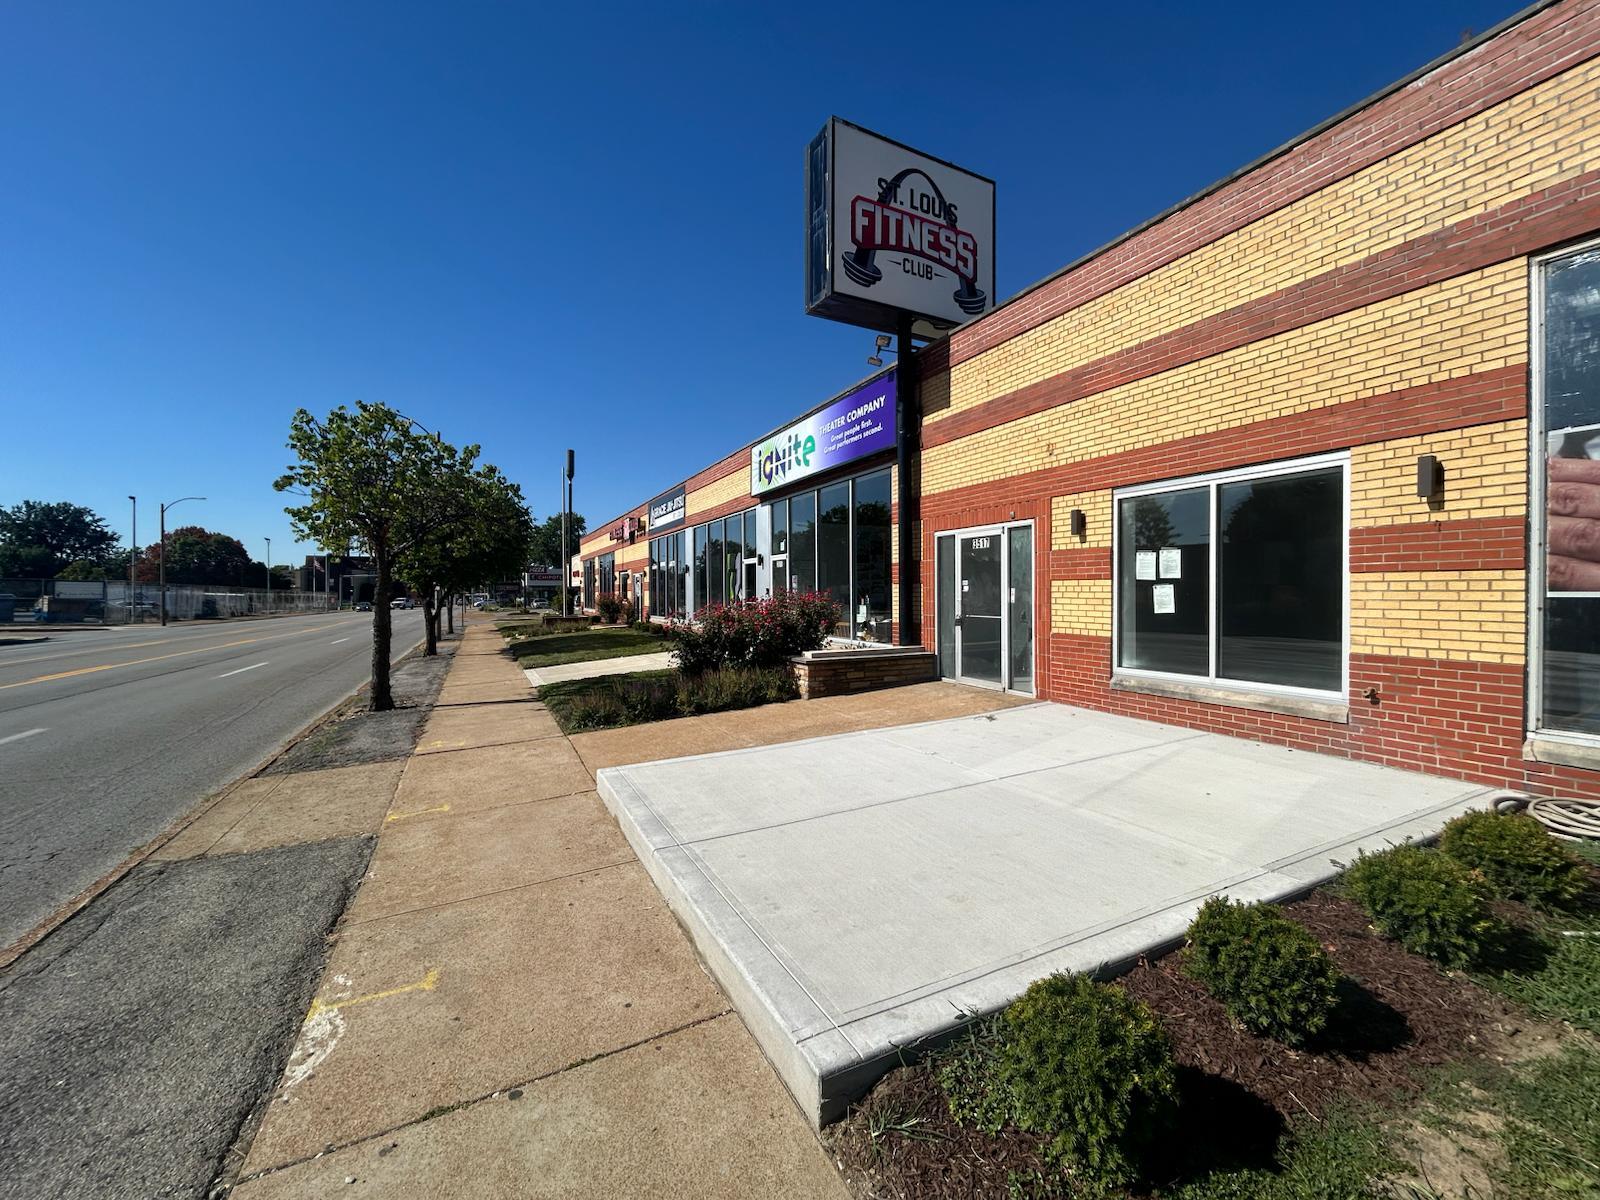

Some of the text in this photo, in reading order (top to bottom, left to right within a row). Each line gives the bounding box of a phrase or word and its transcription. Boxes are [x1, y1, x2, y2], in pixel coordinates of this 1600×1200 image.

[877, 177, 958, 223] ST. LOUIS
[855, 200, 975, 280] FITNESS
[902, 258, 933, 281] CLUB
[820, 395, 886, 435] THEATER COMPANY
[844, 424, 860, 440] people
